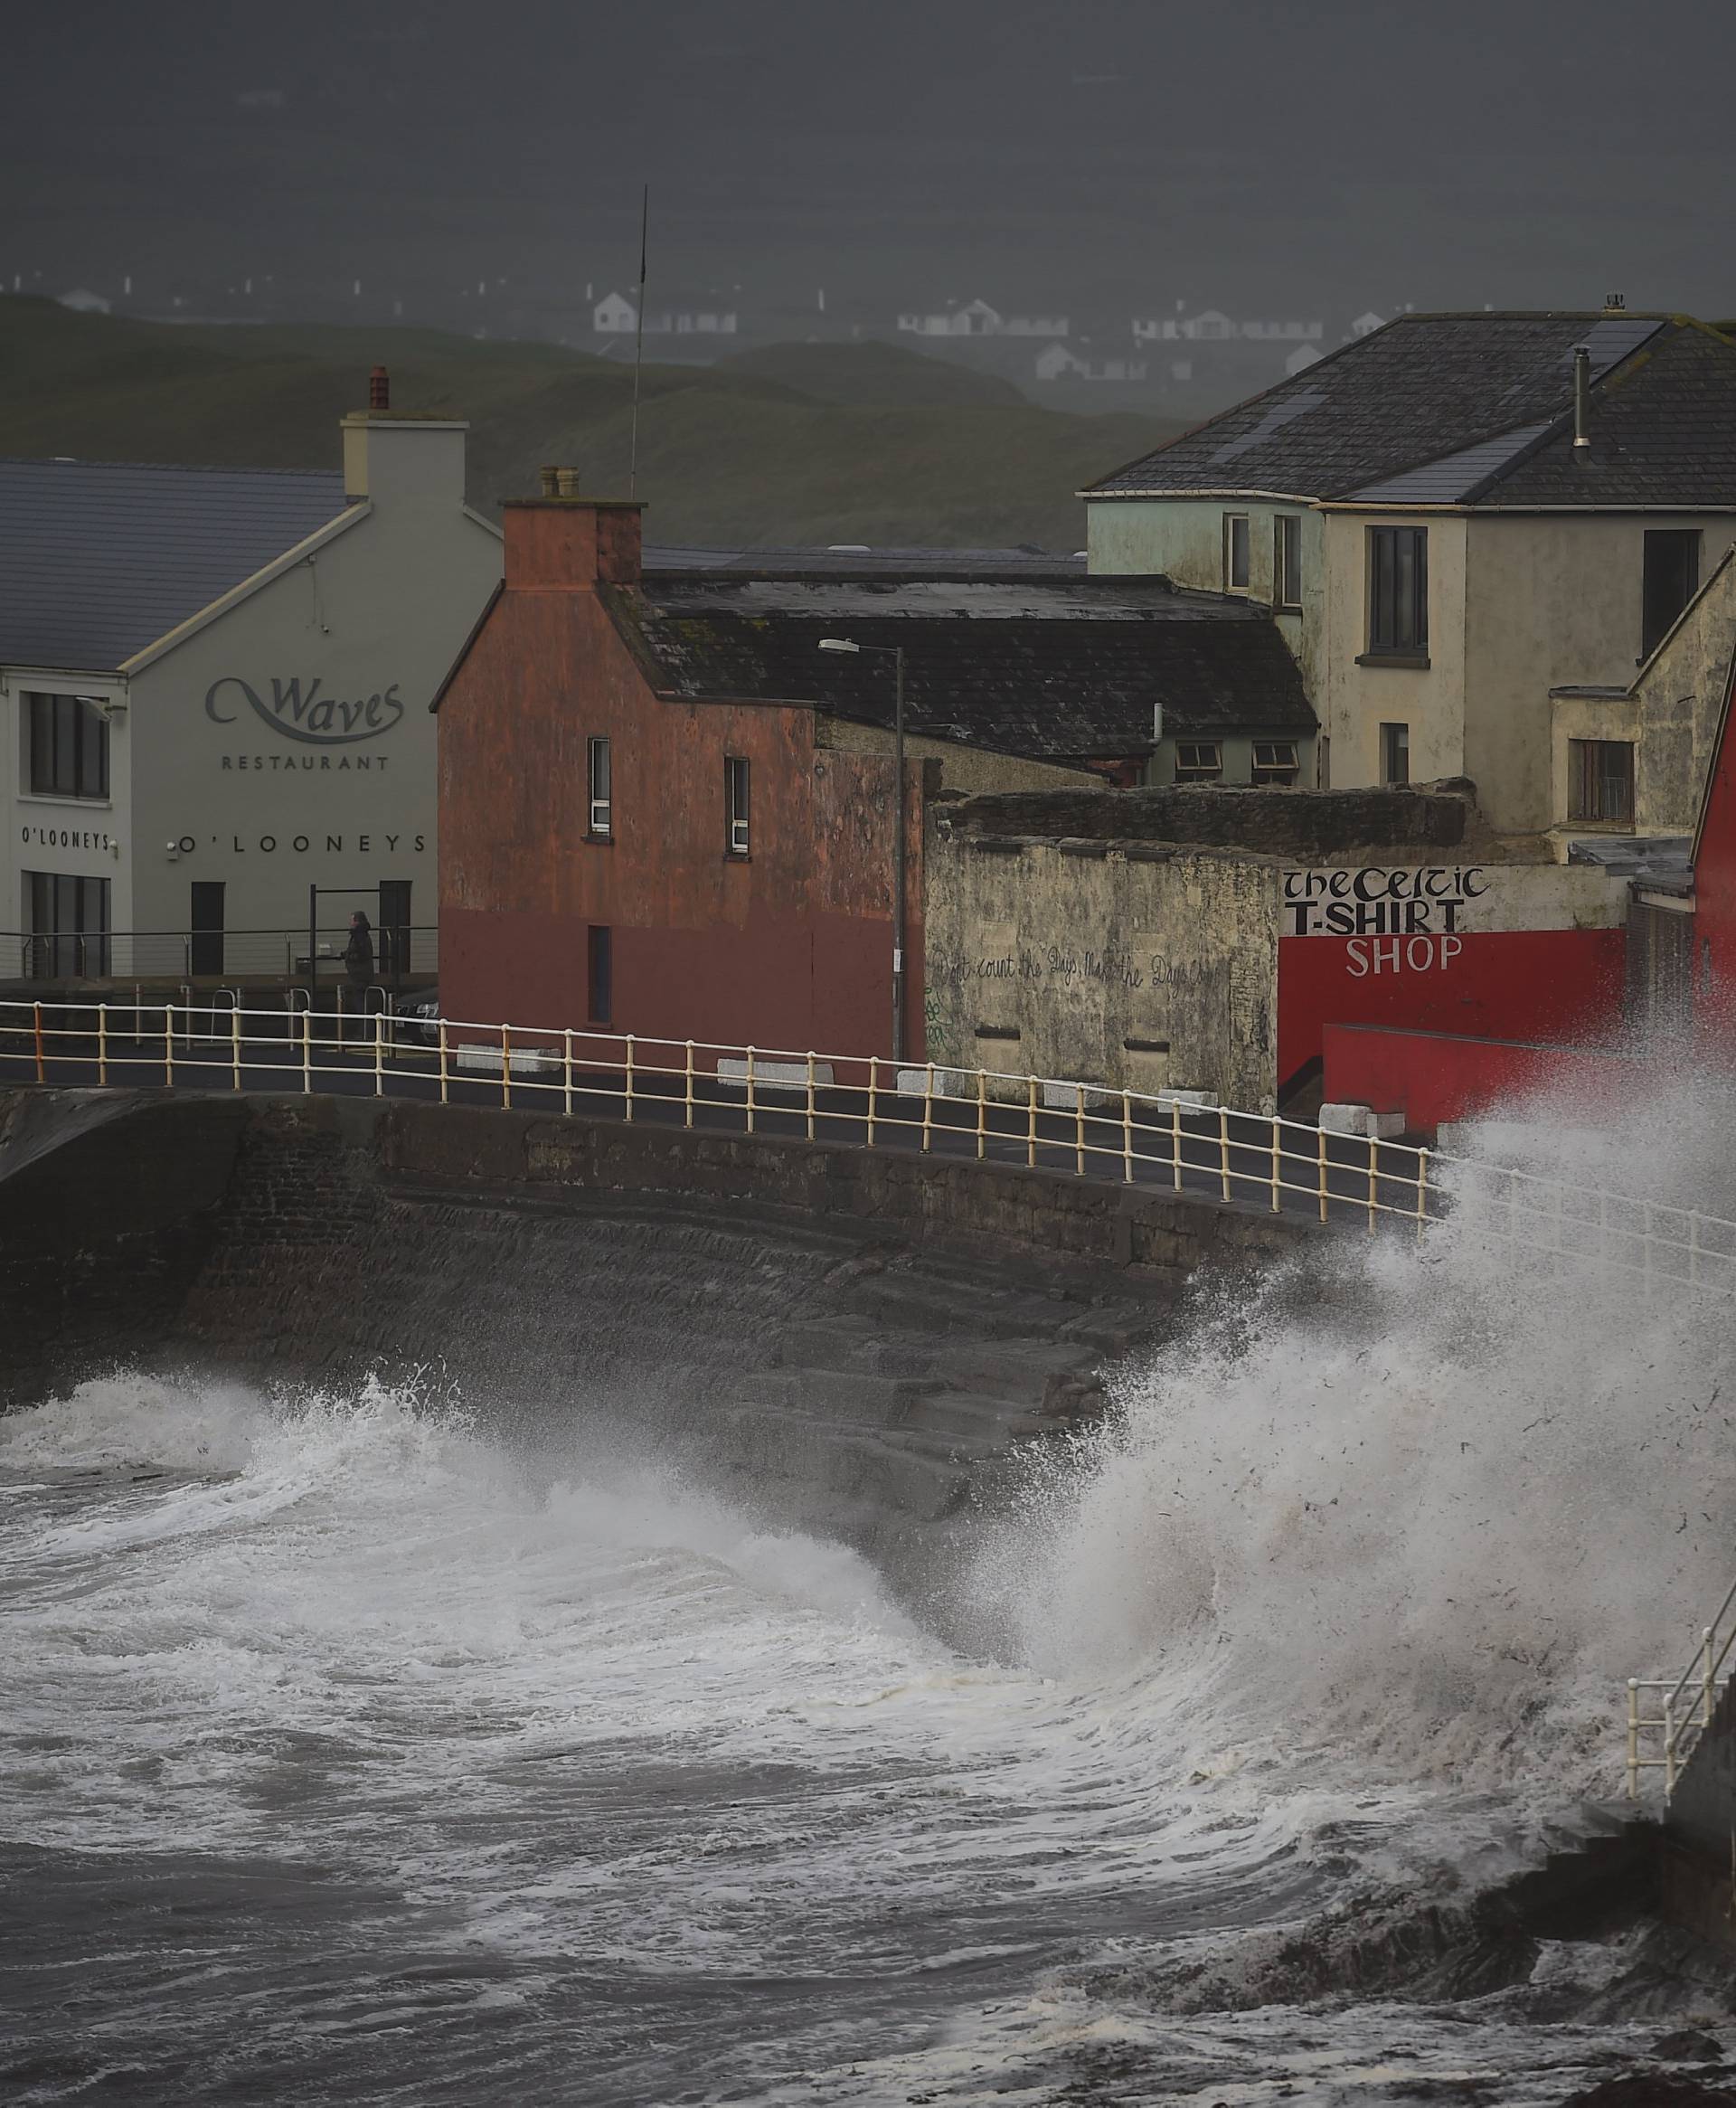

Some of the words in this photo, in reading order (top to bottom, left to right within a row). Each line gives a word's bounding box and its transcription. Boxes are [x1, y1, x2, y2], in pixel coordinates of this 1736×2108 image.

[205, 676, 404, 744] Waves
[222, 756, 389, 770] RESTAURANT
[22, 827, 108, 851] O'LOONEYS
[179, 835, 426, 853] O'LOONEYS
[1285, 899, 1465, 935] T-SHIRT
[1345, 936, 1463, 978] SHOP
